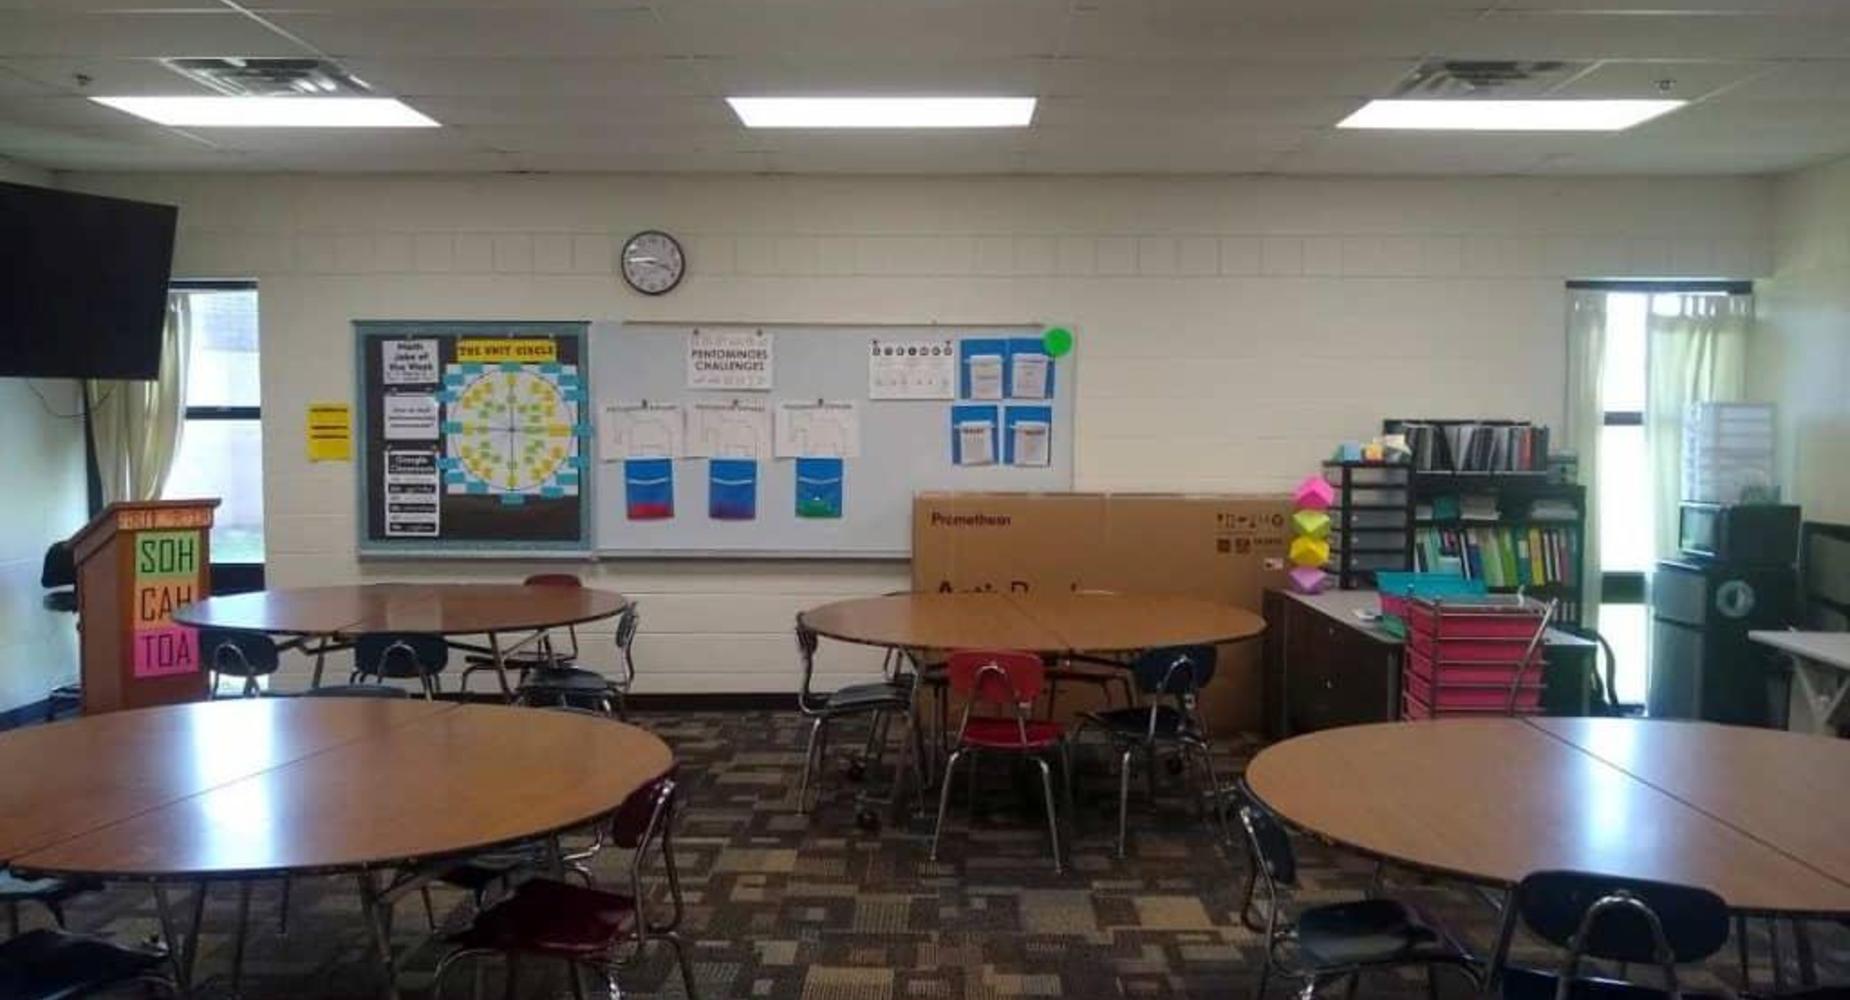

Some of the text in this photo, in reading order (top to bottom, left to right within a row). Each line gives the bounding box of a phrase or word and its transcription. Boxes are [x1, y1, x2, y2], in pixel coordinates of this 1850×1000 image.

[460, 345, 552, 356] THE UNIT CIRCLE
[692, 350, 767, 360] PENTOMINOES
[695, 361, 765, 371] CHALLENGES
[931, 511, 1012, 527] Promethean
[140, 538, 194, 574] SOH
[140, 584, 192, 622] CAH
[140, 632, 192, 670] TOA
